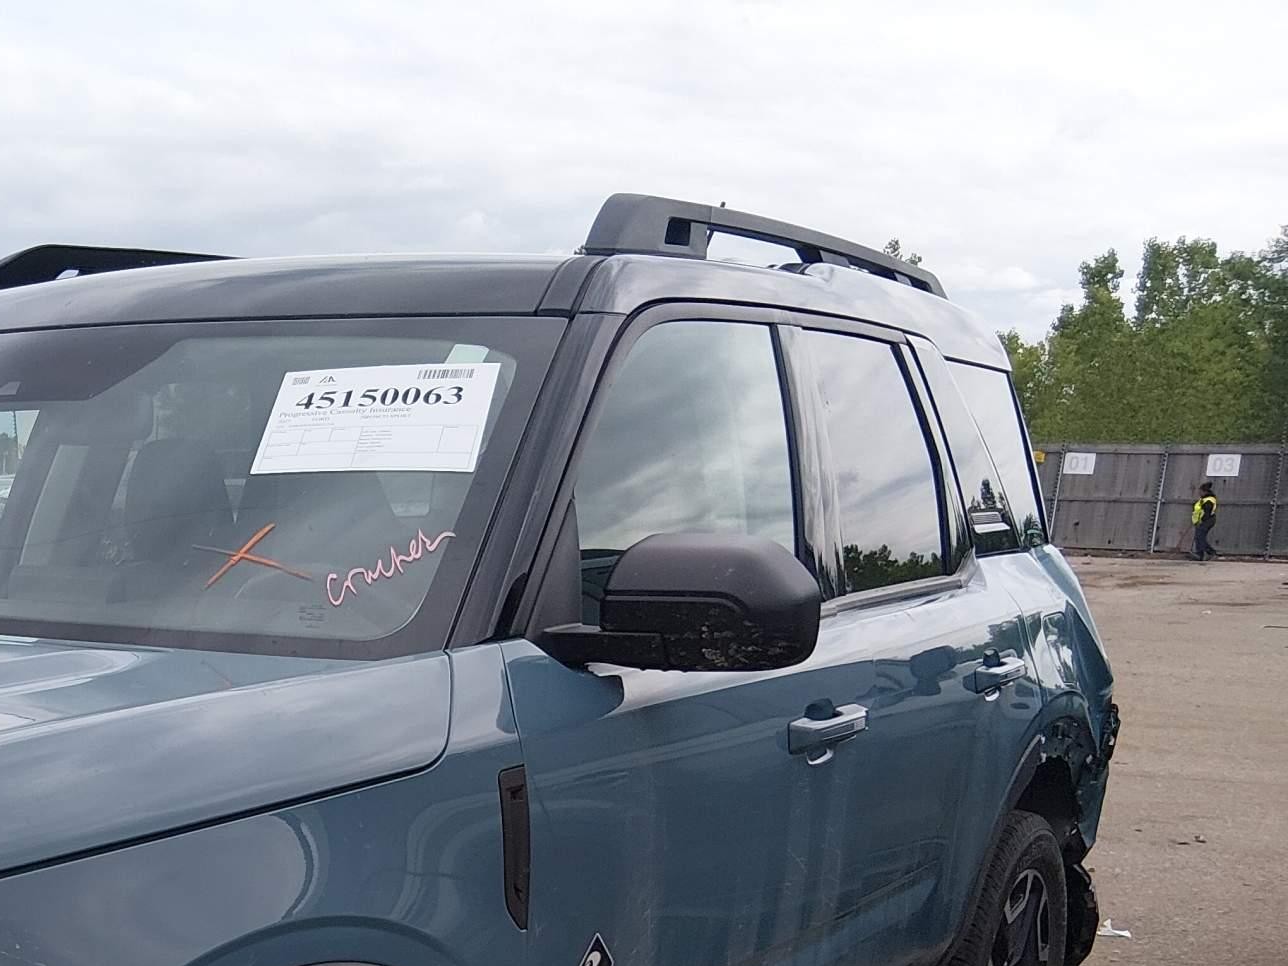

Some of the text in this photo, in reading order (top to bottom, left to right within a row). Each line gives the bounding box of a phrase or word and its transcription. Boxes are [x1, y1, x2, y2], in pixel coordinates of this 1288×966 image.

[295, 386, 464, 410] 45150063
[1068, 455, 1089, 472] 01
[1212, 456, 1236, 473] 03
